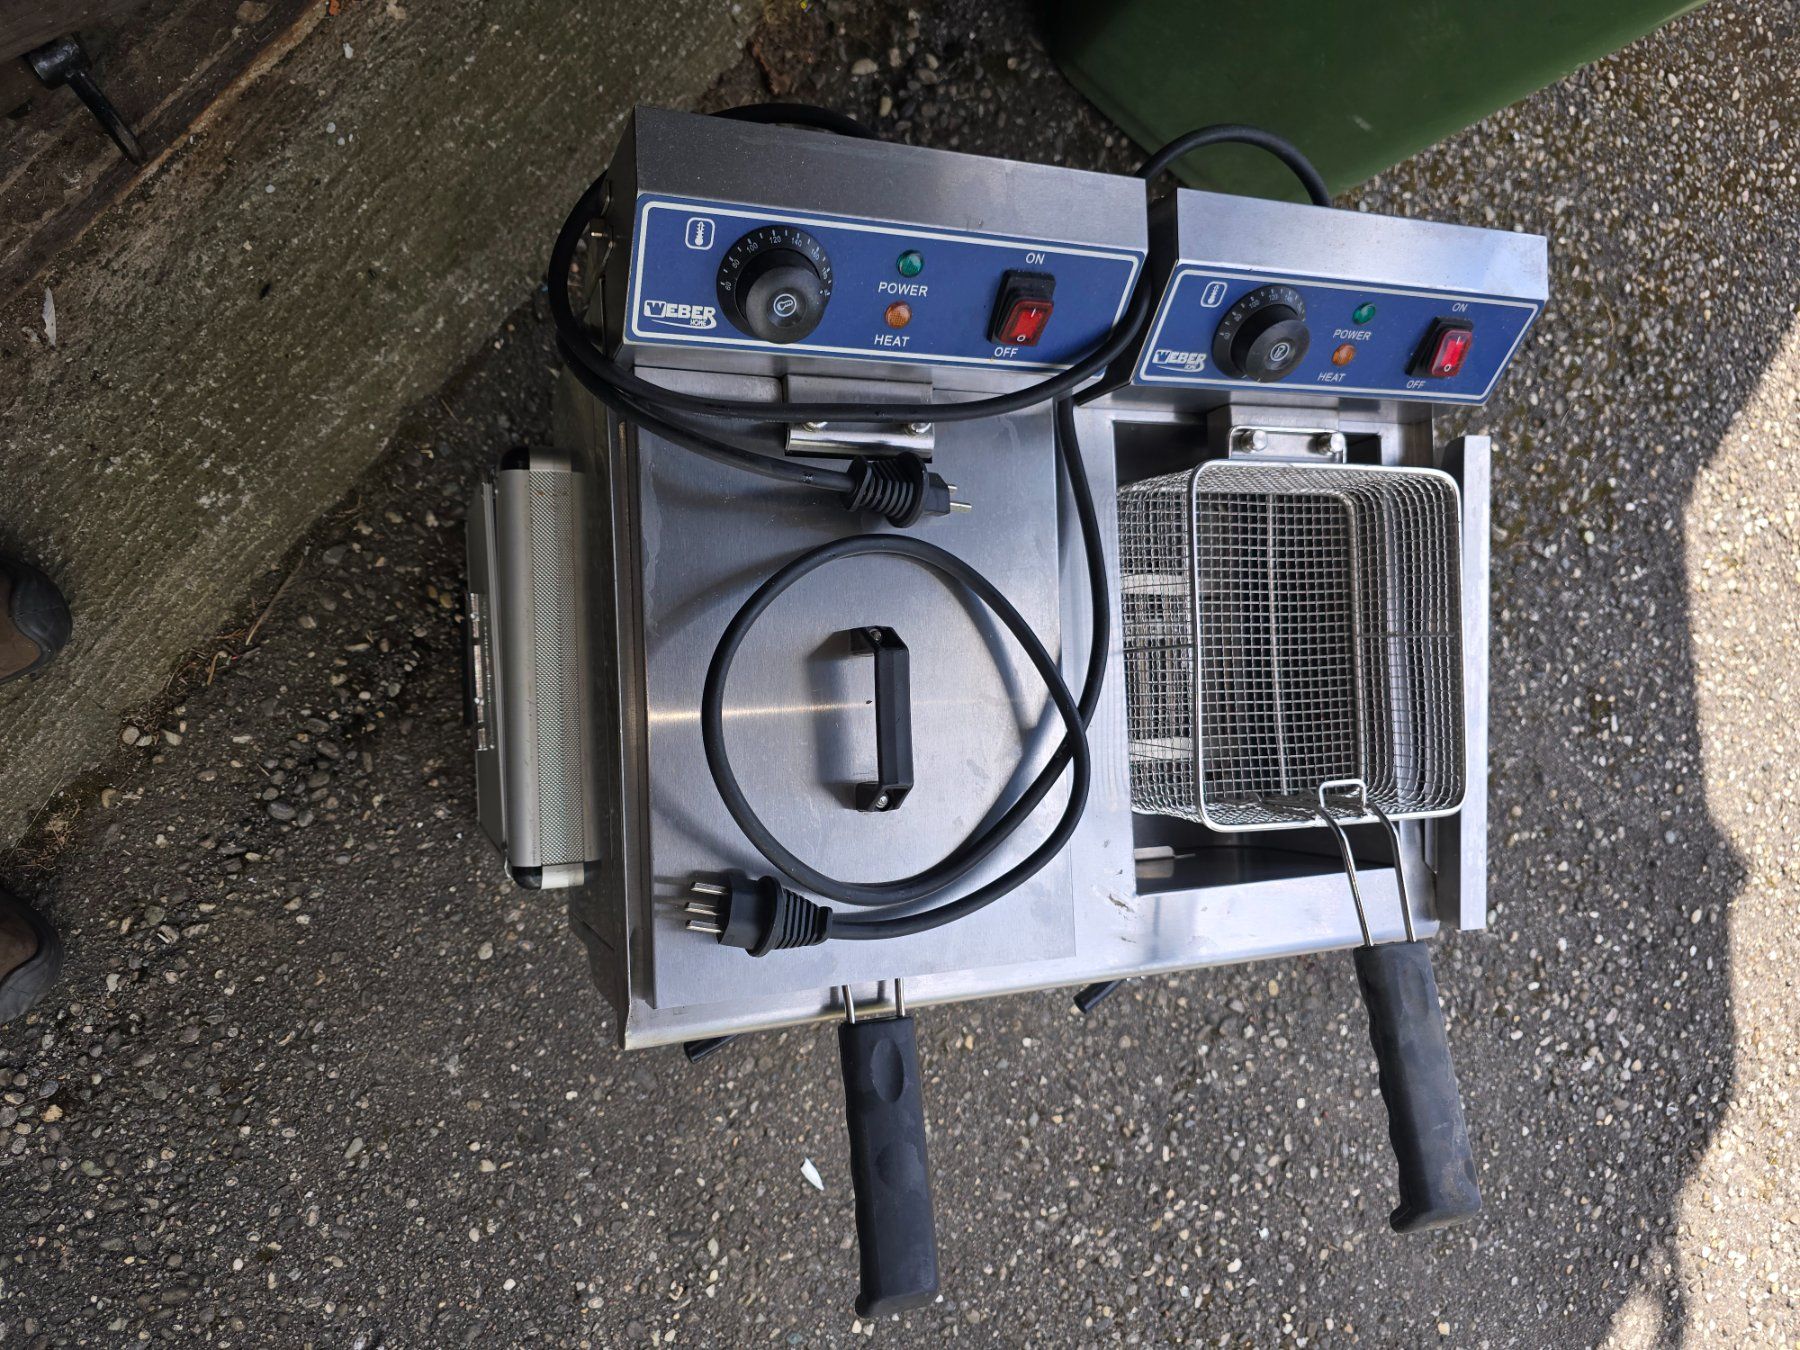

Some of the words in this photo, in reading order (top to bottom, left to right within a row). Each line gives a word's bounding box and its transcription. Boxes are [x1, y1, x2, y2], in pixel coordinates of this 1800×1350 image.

[769, 235, 782, 245] 120
[791, 237, 802, 247] 140
[747, 242, 759, 254] 100
[1025, 252, 1045, 265] ON
[878, 281, 929, 298] POWER
[643, 300, 717, 326] WEBER
[1452, 302, 1468, 313] ON
[874, 334, 910, 348] HEAT
[1333, 329, 1372, 341] POWER
[994, 346, 1019, 359] OFF
[1152, 350, 1207, 370] WEBER
[1317, 372, 1346, 383] HEAT
[1406, 380, 1426, 389] OFF
